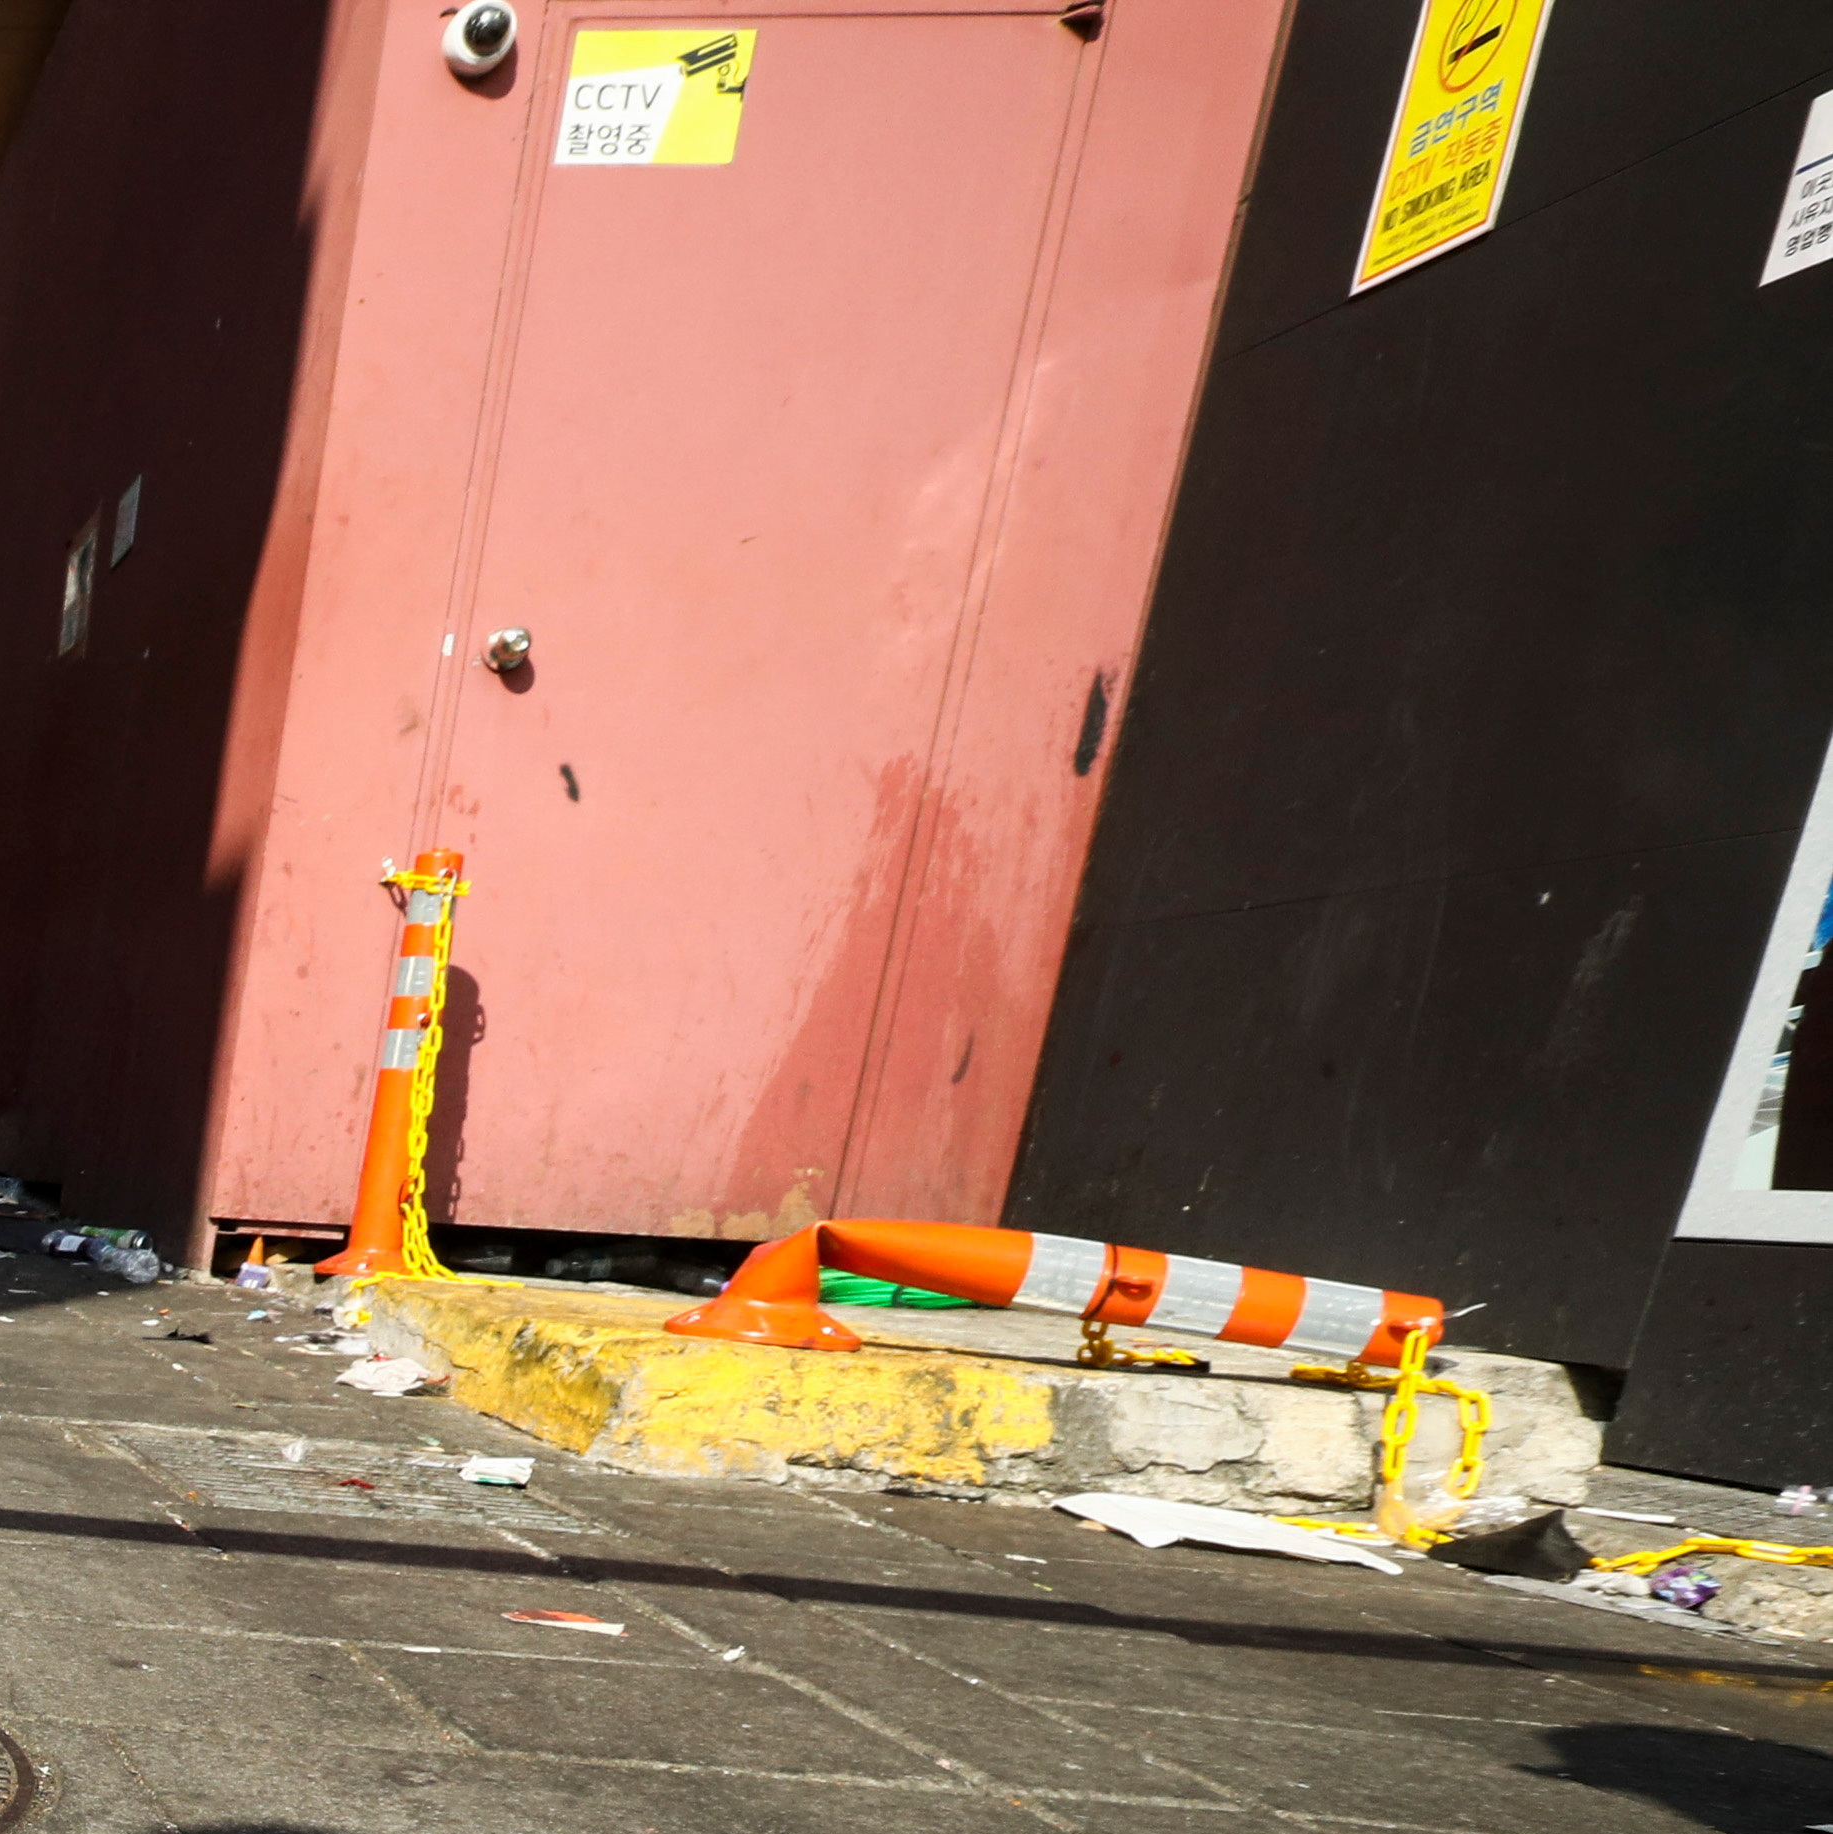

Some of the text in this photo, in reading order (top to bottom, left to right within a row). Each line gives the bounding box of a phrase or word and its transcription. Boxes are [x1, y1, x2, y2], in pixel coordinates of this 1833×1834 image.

[574, 83, 662, 110] CCTV
[1409, 77, 1505, 158] 금연구역
[567, 122, 653, 156] 촬영중
[1389, 116, 1503, 200] CCTV 작동중
[1399, 176, 1457, 225] SMOKING
[1458, 158, 1492, 195] AREA
